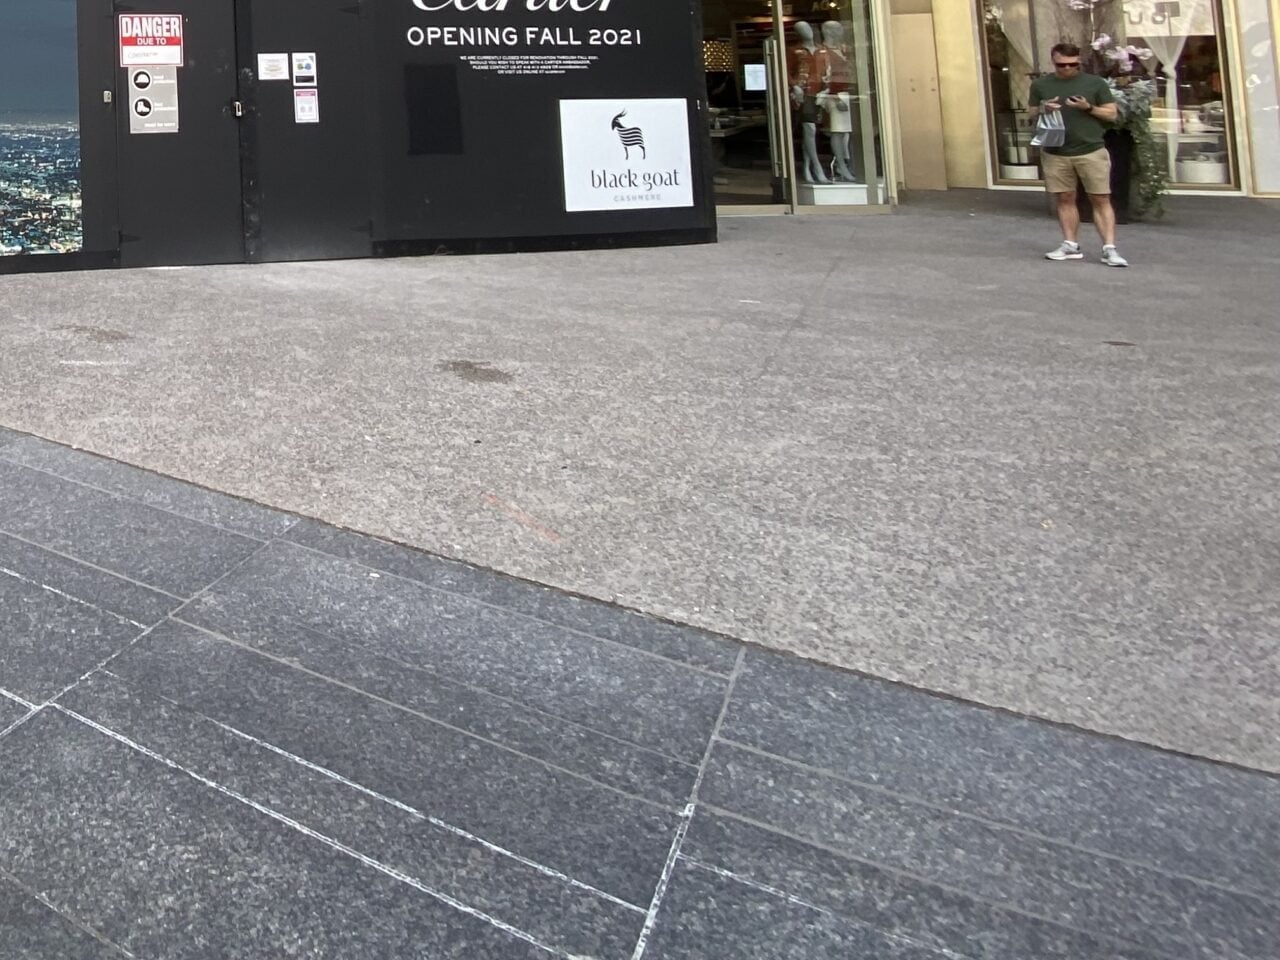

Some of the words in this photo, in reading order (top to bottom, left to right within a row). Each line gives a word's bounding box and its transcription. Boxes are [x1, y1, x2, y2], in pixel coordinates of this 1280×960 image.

[121, 16, 181, 37] DANGER
[407, 26, 518, 46] OPENING
[525, 27, 582, 45] FALL
[588, 29, 641, 45] 2021
[137, 37, 154, 45] DUE
[156, 37, 167, 45] TO
[591, 169, 639, 189] black
[642, 168, 680, 191] goat
